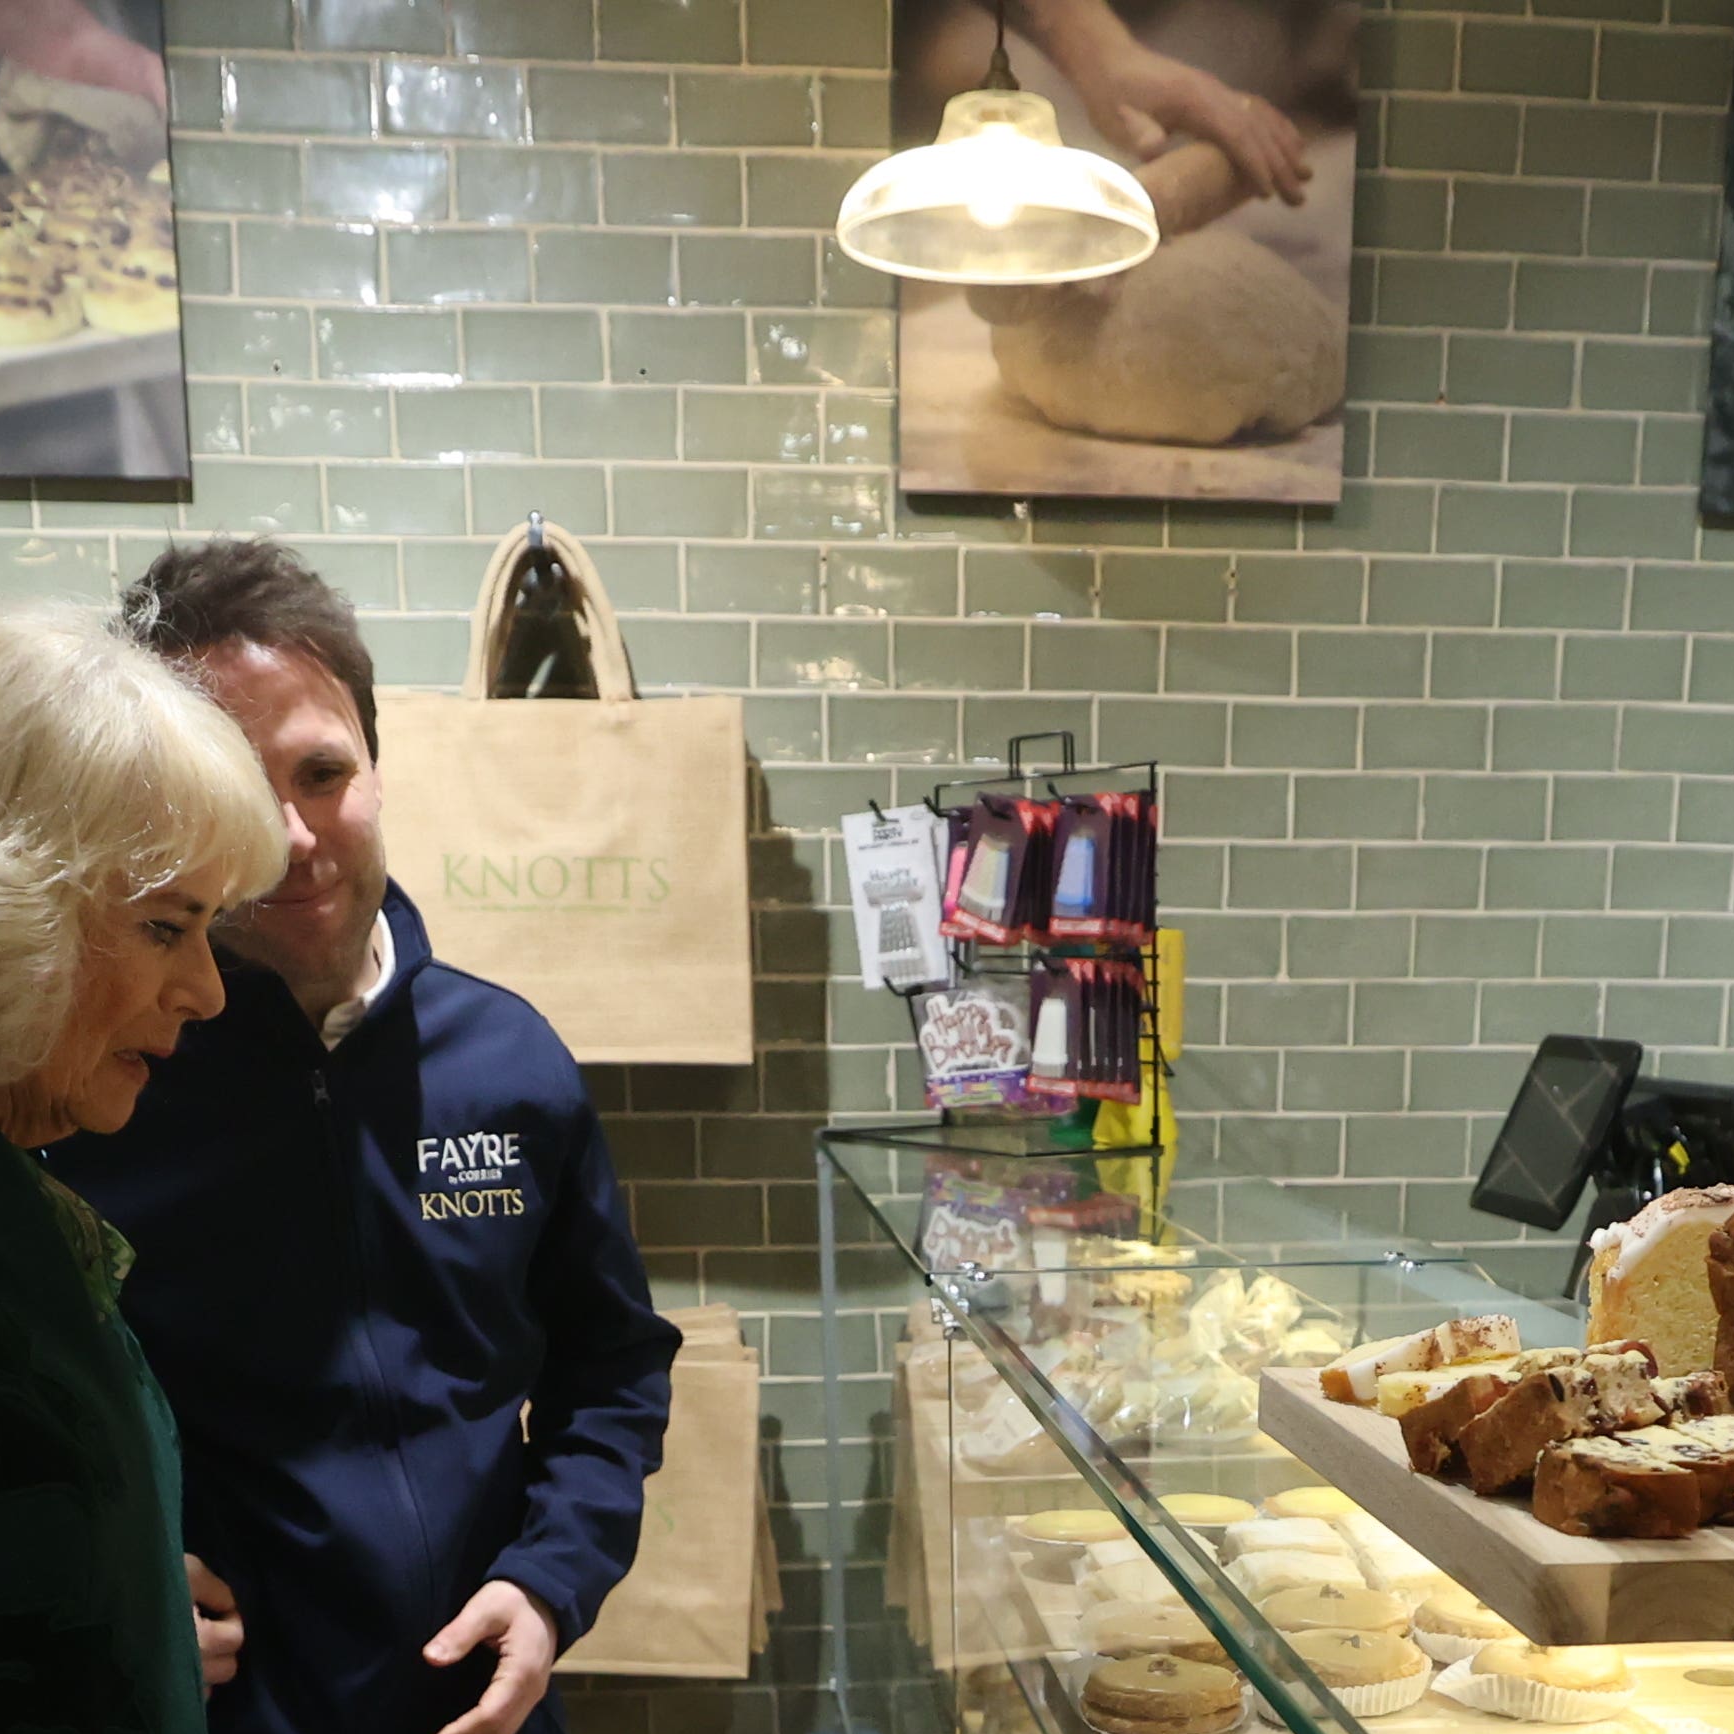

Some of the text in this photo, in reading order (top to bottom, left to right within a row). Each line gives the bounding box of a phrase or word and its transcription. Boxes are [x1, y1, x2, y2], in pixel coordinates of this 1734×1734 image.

[441, 852, 672, 902] KNOTTS
[417, 1131, 521, 1173] FAYRE
[419, 1188, 525, 1221] KNOTTS
